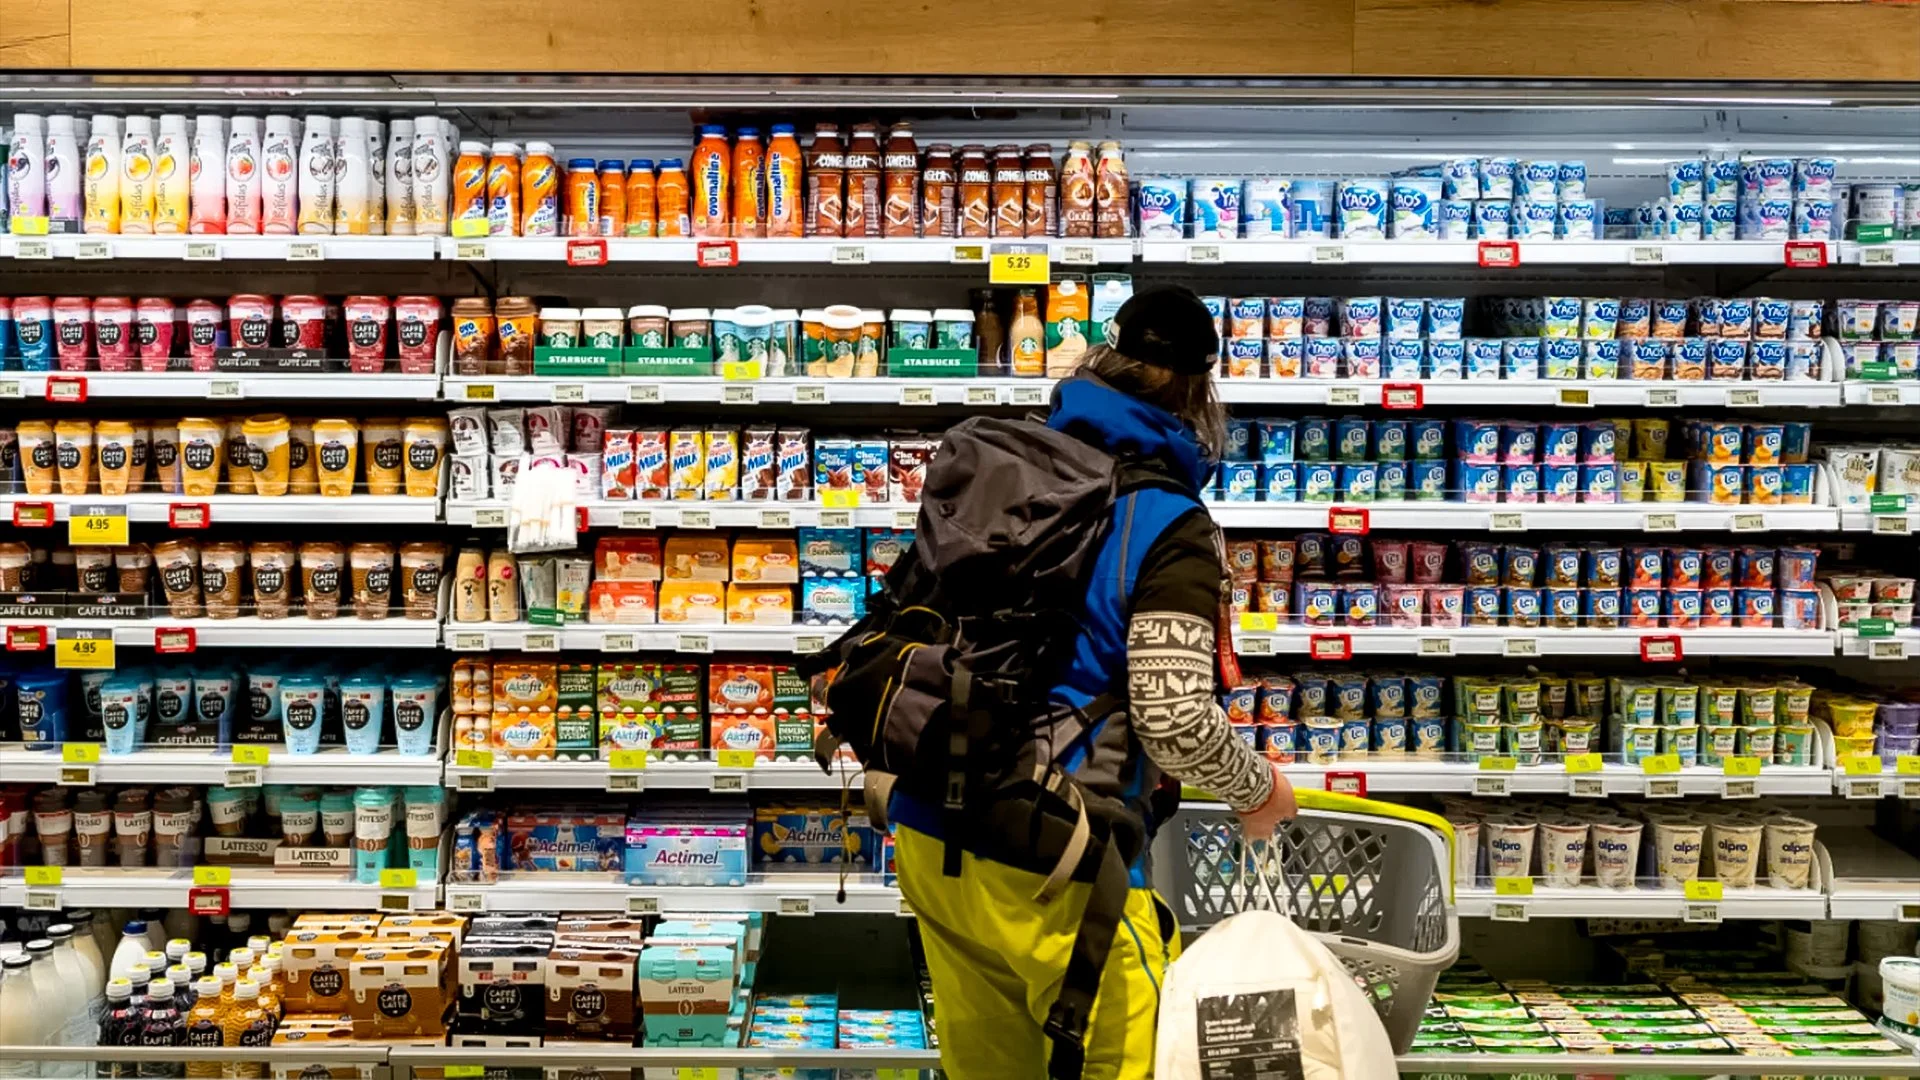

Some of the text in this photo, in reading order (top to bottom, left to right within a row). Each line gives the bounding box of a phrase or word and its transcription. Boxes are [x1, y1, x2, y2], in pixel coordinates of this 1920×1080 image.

[821, 154, 844, 168] COME
[709, 153, 720, 217] ovomaltine
[772, 153, 783, 217] ovomaltine
[234, 183, 247, 221] Bifidus
[274, 183, 287, 221] Bifidus
[1143, 191, 1171, 206] YAOS
[1222, 191, 1241, 206] YA
[1345, 192, 1376, 207] YAOS
[1007, 258, 1030, 270] 5.25
[1239, 304, 1261, 317] YAOS
[1274, 304, 1298, 316] YAOS
[1396, 306, 1419, 317] YAOS
[1436, 306, 1460, 318] YAOS
[356, 331, 377, 339] LATTE
[1239, 345, 1259, 357] YAOS
[549, 355, 605, 364] STARBUCKS
[637, 357, 694, 365] STARBUCKS
[904, 358, 961, 366] STARBUCKS
[607, 452, 630, 467] MILK
[639, 452, 663, 468] MILK
[674, 453, 697, 470] MILK
[708, 451, 732, 469] MILK
[748, 452, 771, 470] MILK
[780, 453, 804, 469] MILK
[86, 518, 109, 531] 4.95
[168, 577, 191, 586] LATTE
[259, 578, 281, 587] LATTE
[316, 578, 337, 586] LATTE
[370, 579, 389, 587] LATTE
[417, 578, 436, 586] LATTE
[78, 605, 136, 617] CAFFÈ LATTE
[73, 641, 96, 655] 4.95
[507, 681, 541, 693] Aktifit
[612, 682, 647, 693] Aktifit
[724, 683, 759, 694] Aktifit
[506, 729, 540, 741] Aktifit
[614, 731, 649, 742] Aktifit
[726, 732, 760, 742] Aktifit
[358, 813, 389, 823] ATTESSO
[786, 828, 841, 843] Actime
[221, 840, 268, 852] LATTESSO
[539, 839, 595, 853] Actimel
[1492, 839, 1521, 852] alpro
[1567, 841, 1584, 852] alp
[1599, 839, 1627, 852] alpro
[1718, 840, 1747, 853] alpro
[291, 850, 338, 861] LATTESSO
[655, 850, 718, 864] Actimel
[313, 974, 339, 982] CAFFÈ
[380, 993, 408, 1001] CAFFÈ
[489, 988, 516, 996] CAFFÈ
[575, 993, 601, 1002] CAFFÈ
[577, 1001, 601, 1009] LATTE
